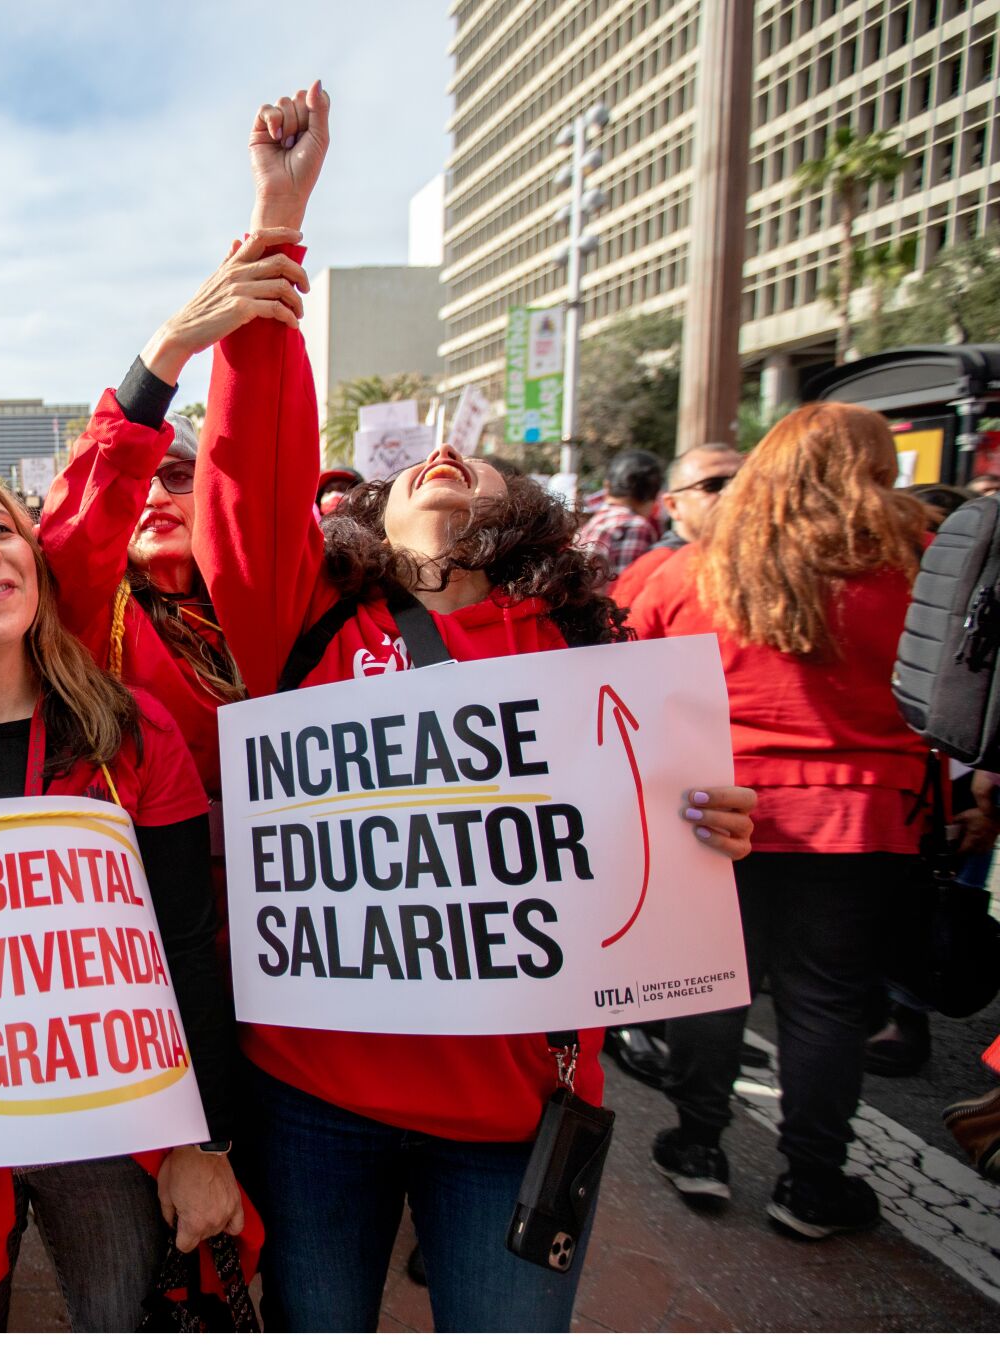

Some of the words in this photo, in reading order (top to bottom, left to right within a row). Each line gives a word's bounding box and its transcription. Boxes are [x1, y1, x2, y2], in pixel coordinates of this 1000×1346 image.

[245, 699, 549, 802] INCREASE
[251, 803, 594, 893] EDUCATOR
[256, 898, 564, 981] SALARIES
[594, 988, 634, 1009] UTLA
[642, 979, 681, 994] UNITED
[683, 970, 735, 988] TEACHERS
[643, 992, 662, 1003] LOS
[665, 984, 714, 1000] ANGELES
